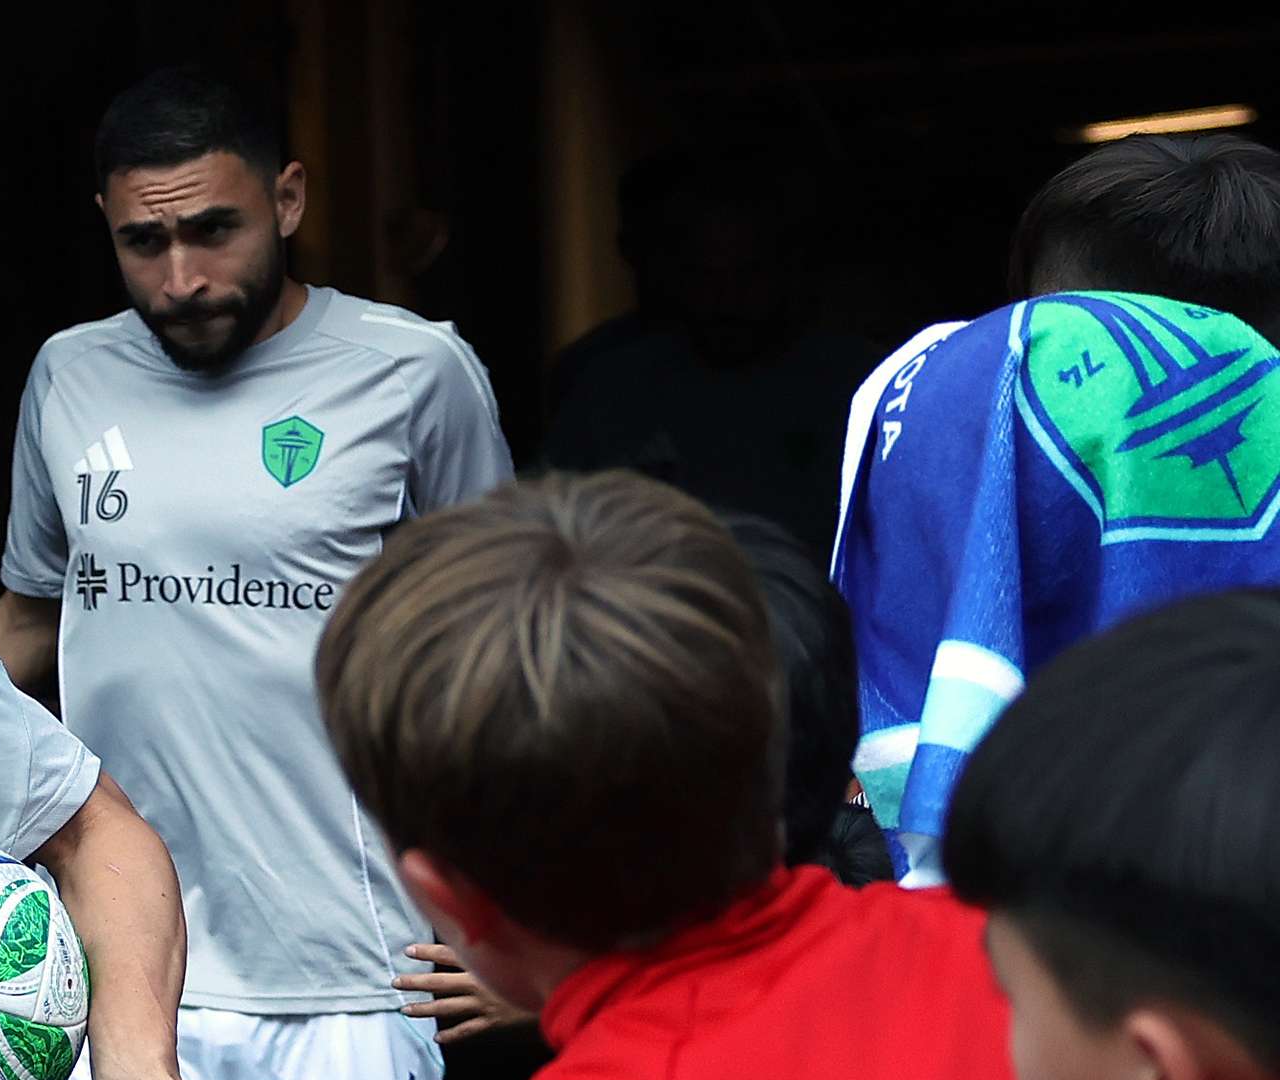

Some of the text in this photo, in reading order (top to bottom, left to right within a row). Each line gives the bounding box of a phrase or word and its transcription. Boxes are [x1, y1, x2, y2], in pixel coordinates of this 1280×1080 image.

[1057, 350, 1106, 388] 74
[77, 470, 128, 524] 16
[118, 563, 333, 611] Providence
